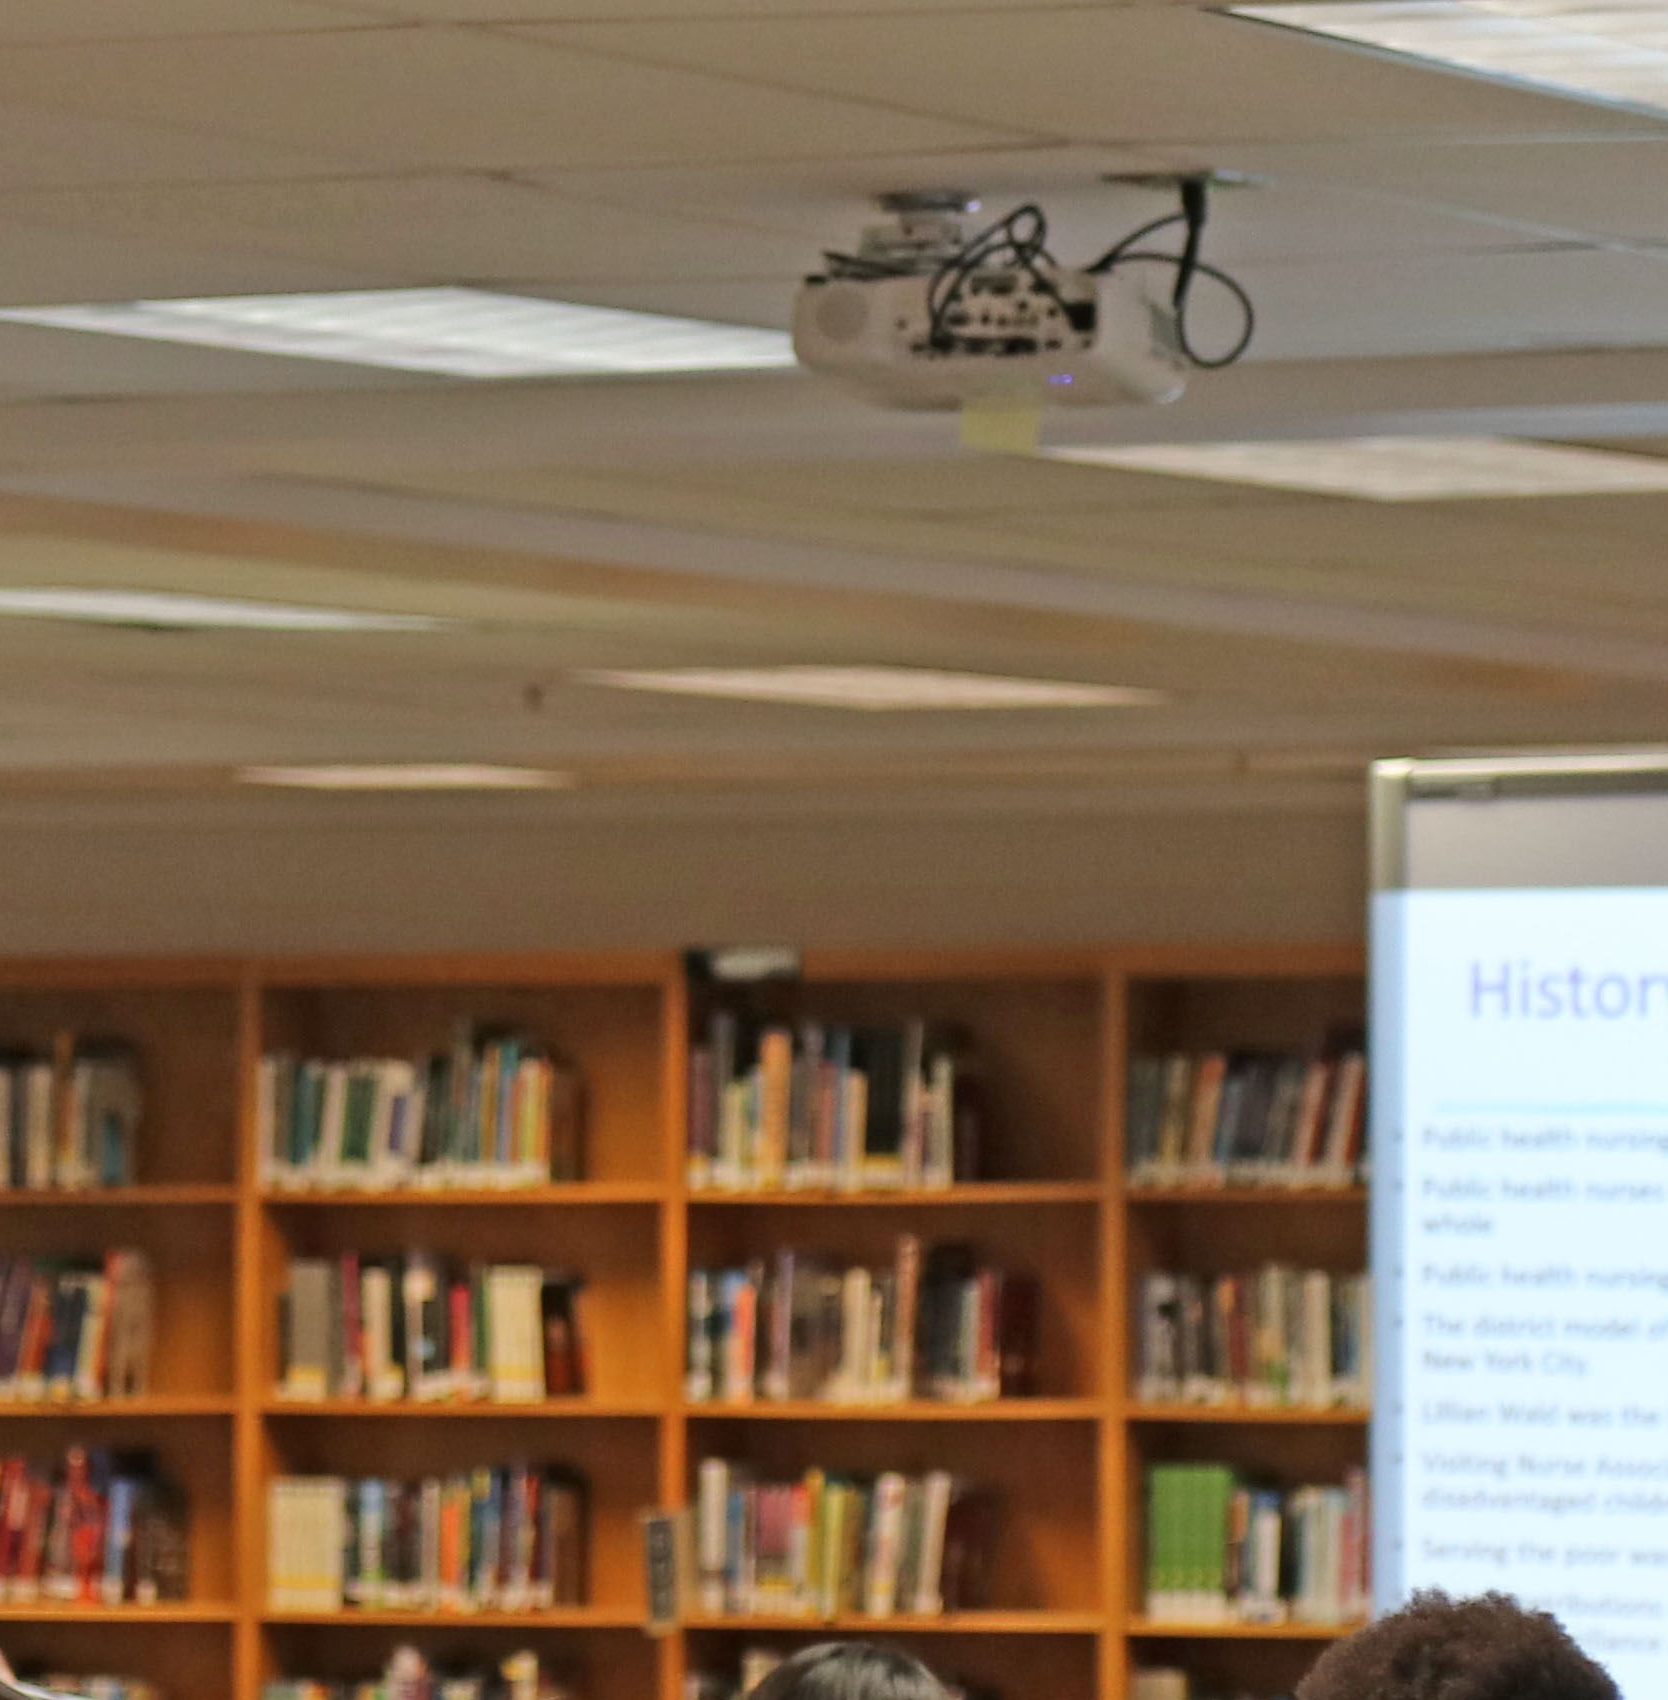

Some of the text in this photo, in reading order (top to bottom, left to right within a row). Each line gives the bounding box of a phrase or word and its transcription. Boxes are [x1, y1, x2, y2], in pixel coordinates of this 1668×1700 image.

[1425, 1127, 1490, 1150] Public
[1500, 1127, 1577, 1150] health
[1425, 1177, 1490, 1201] Public
[1500, 1178, 1577, 1201] health
[1585, 1183, 1664, 1202] nurses
[1425, 1215, 1493, 1236] whole
[1425, 1264, 1490, 1287] Public
[1501, 1264, 1577, 1288] health
[1425, 1313, 1465, 1337] The
[1564, 1318, 1639, 1340] model
[1425, 1351, 1474, 1372] New
[1483, 1350, 1531, 1373] York
[1499, 1402, 1559, 1426] Wald
[1568, 1409, 1612, 1427] was
[1620, 1406, 1659, 1427] the
[1517, 1455, 1585, 1476] Nurse
[1517, 1542, 1555, 1564] the
[1565, 1546, 1619, 1567] poor
